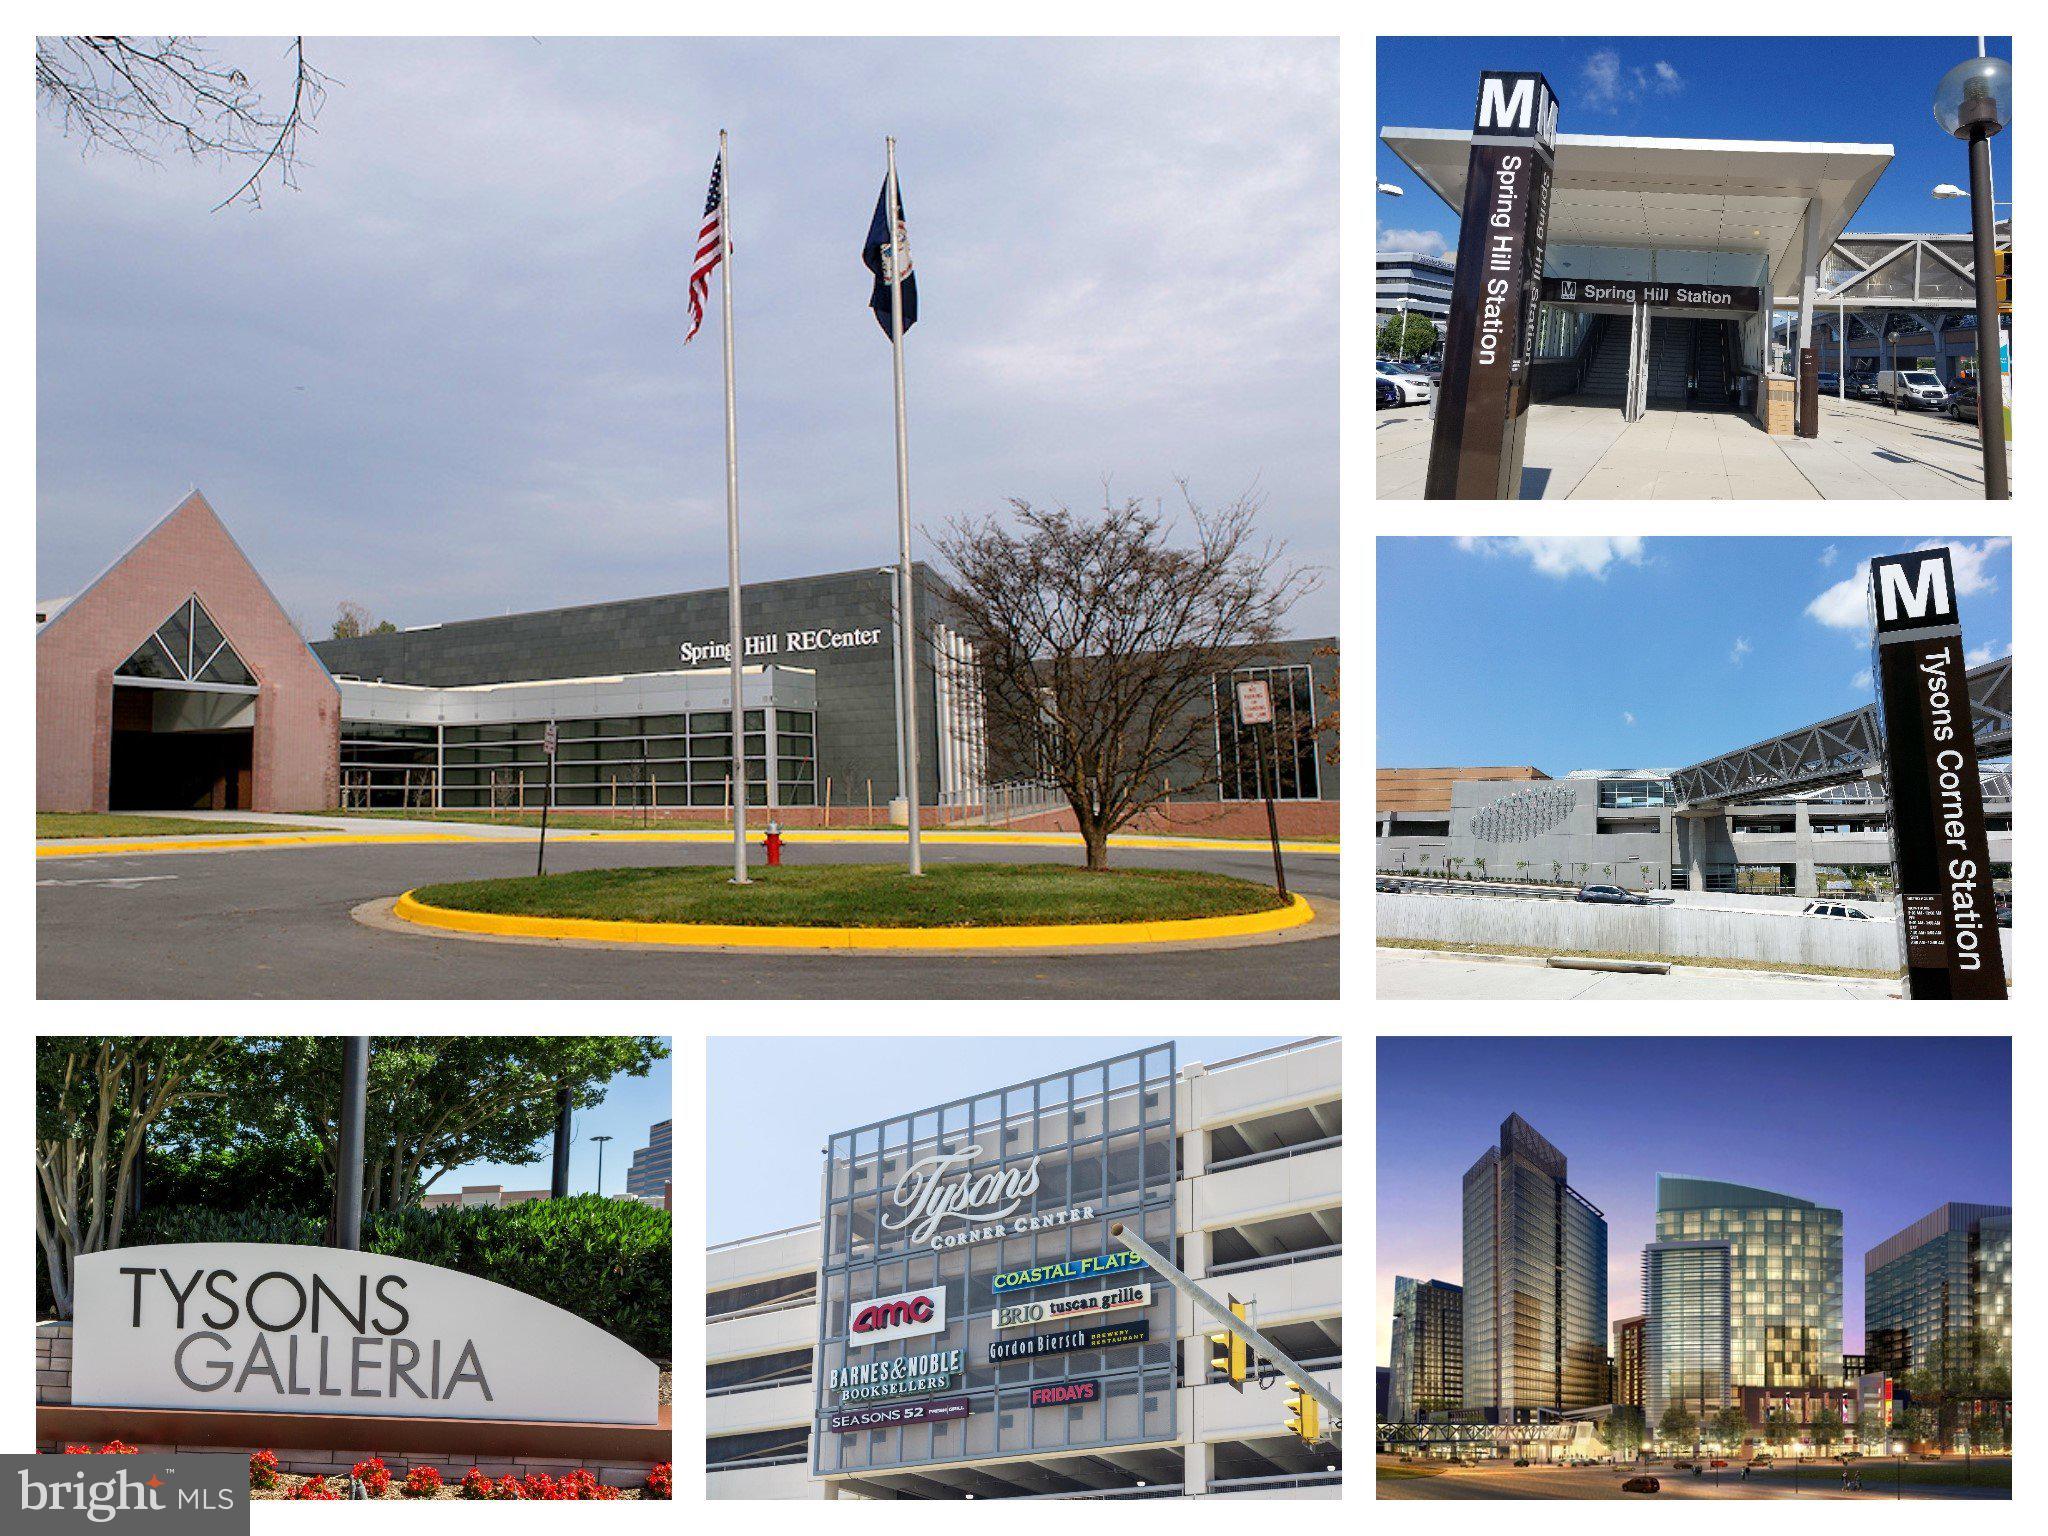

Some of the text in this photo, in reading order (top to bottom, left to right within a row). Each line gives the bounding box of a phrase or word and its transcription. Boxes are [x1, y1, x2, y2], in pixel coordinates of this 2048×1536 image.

[1479, 78, 1535, 128] M
[1479, 155, 1521, 366] Spring Hill Station
[1584, 284, 1732, 305] Spring Hill Station
[1879, 557, 1950, 621] M
[680, 627, 881, 665] Spring Hill RECenter
[1920, 646, 1983, 970] Tysons Corner Station
[881, 1144, 1040, 1244] Tysons
[930, 1206, 1096, 1250] CORNER CENTER
[994, 1250, 1142, 1289] COASTAL FLATS
[119, 1267, 410, 1336] TYSONS
[997, 1287, 1144, 1328] BRIO tuscan grille
[990, 1330, 1085, 1359] Gordon Biersch
[1091, 1329, 1130, 1340] BREWERY
[1091, 1333, 1144, 1347] RESTAURANT
[174, 1331, 494, 1402] GALLERIA
[842, 1376, 946, 1401] BOOKSELLERS
[1032, 1383, 1094, 1405] FRIDAYS
[832, 1410, 901, 1428] SEASONS
[903, 1407, 924, 1419] 52
